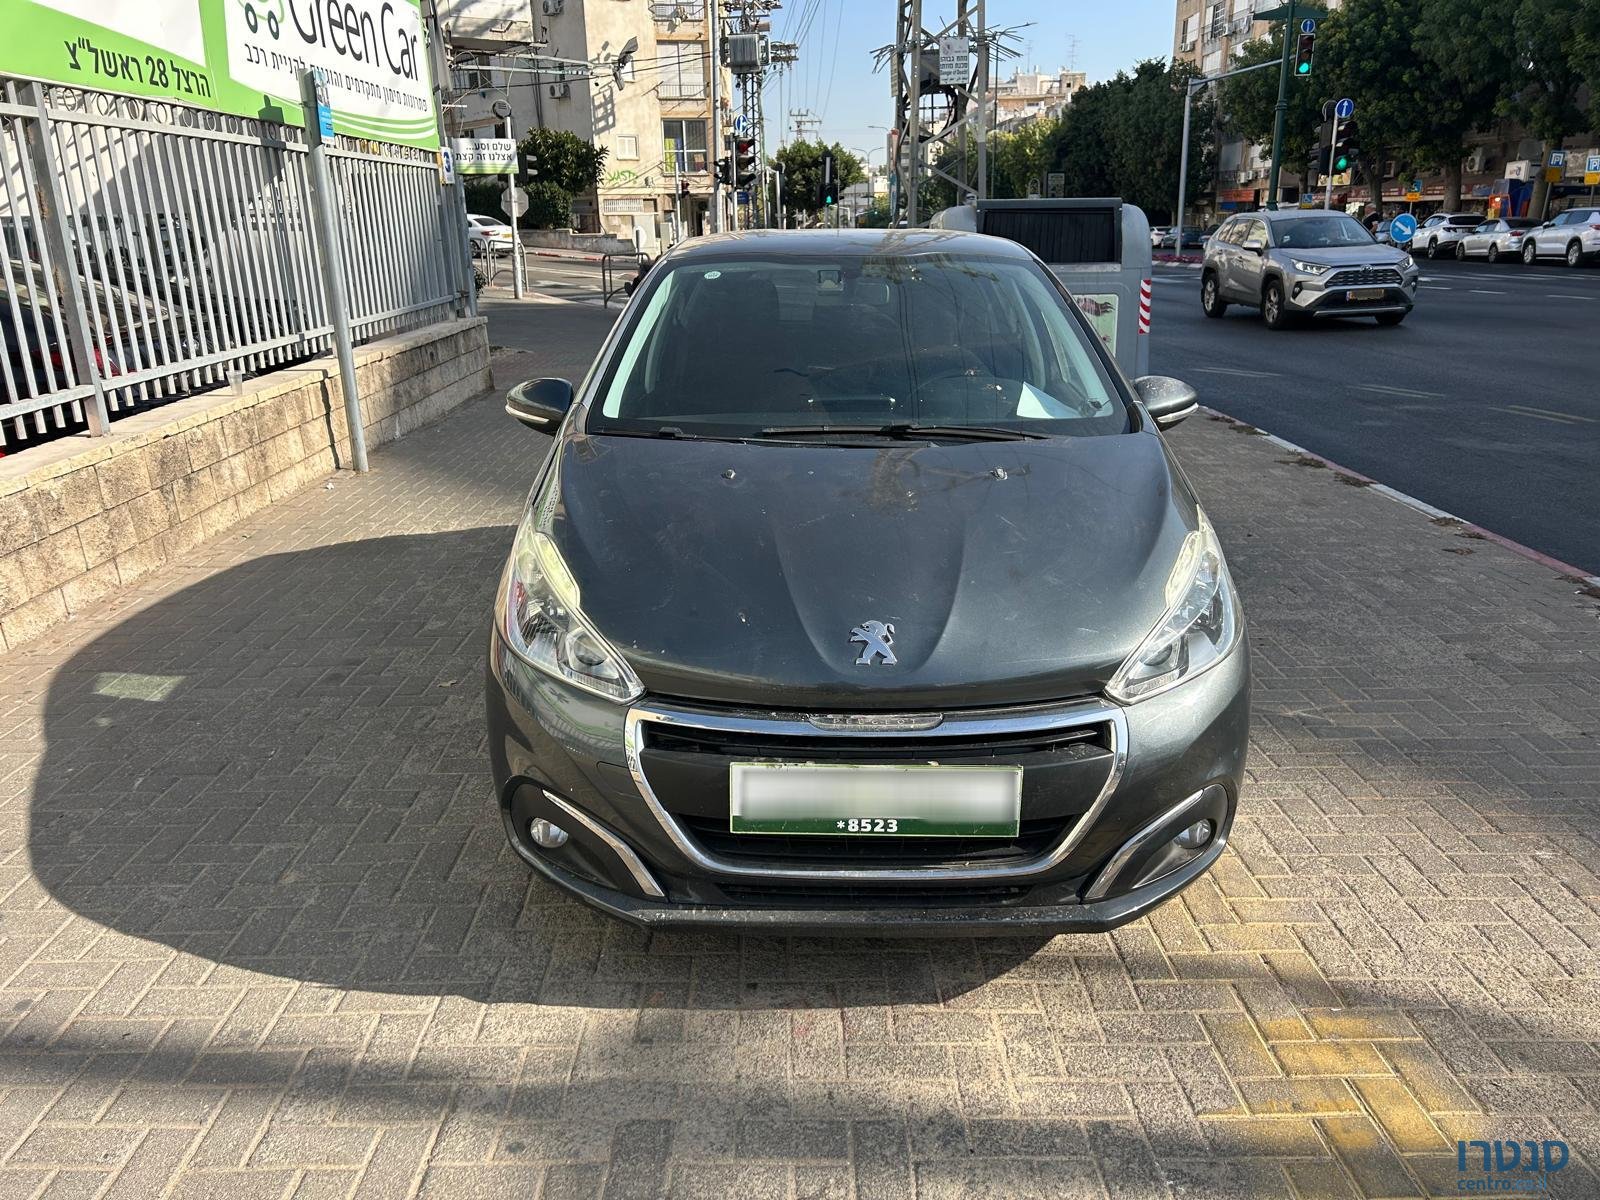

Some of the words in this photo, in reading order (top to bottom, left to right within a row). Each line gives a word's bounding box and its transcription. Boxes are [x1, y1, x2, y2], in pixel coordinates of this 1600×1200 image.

[380, 2, 419, 81] Car
[244, 43, 268, 67] רכב
[145, 55, 169, 89] 28
[169, 59, 211, 98] הרצל
[344, 74, 382, 101] מתקדמים
[455, 153, 474, 163] קצת
[476, 152, 486, 161] זה
[489, 152, 513, 161] אצלנו
[492, 141, 512, 151] שלם
